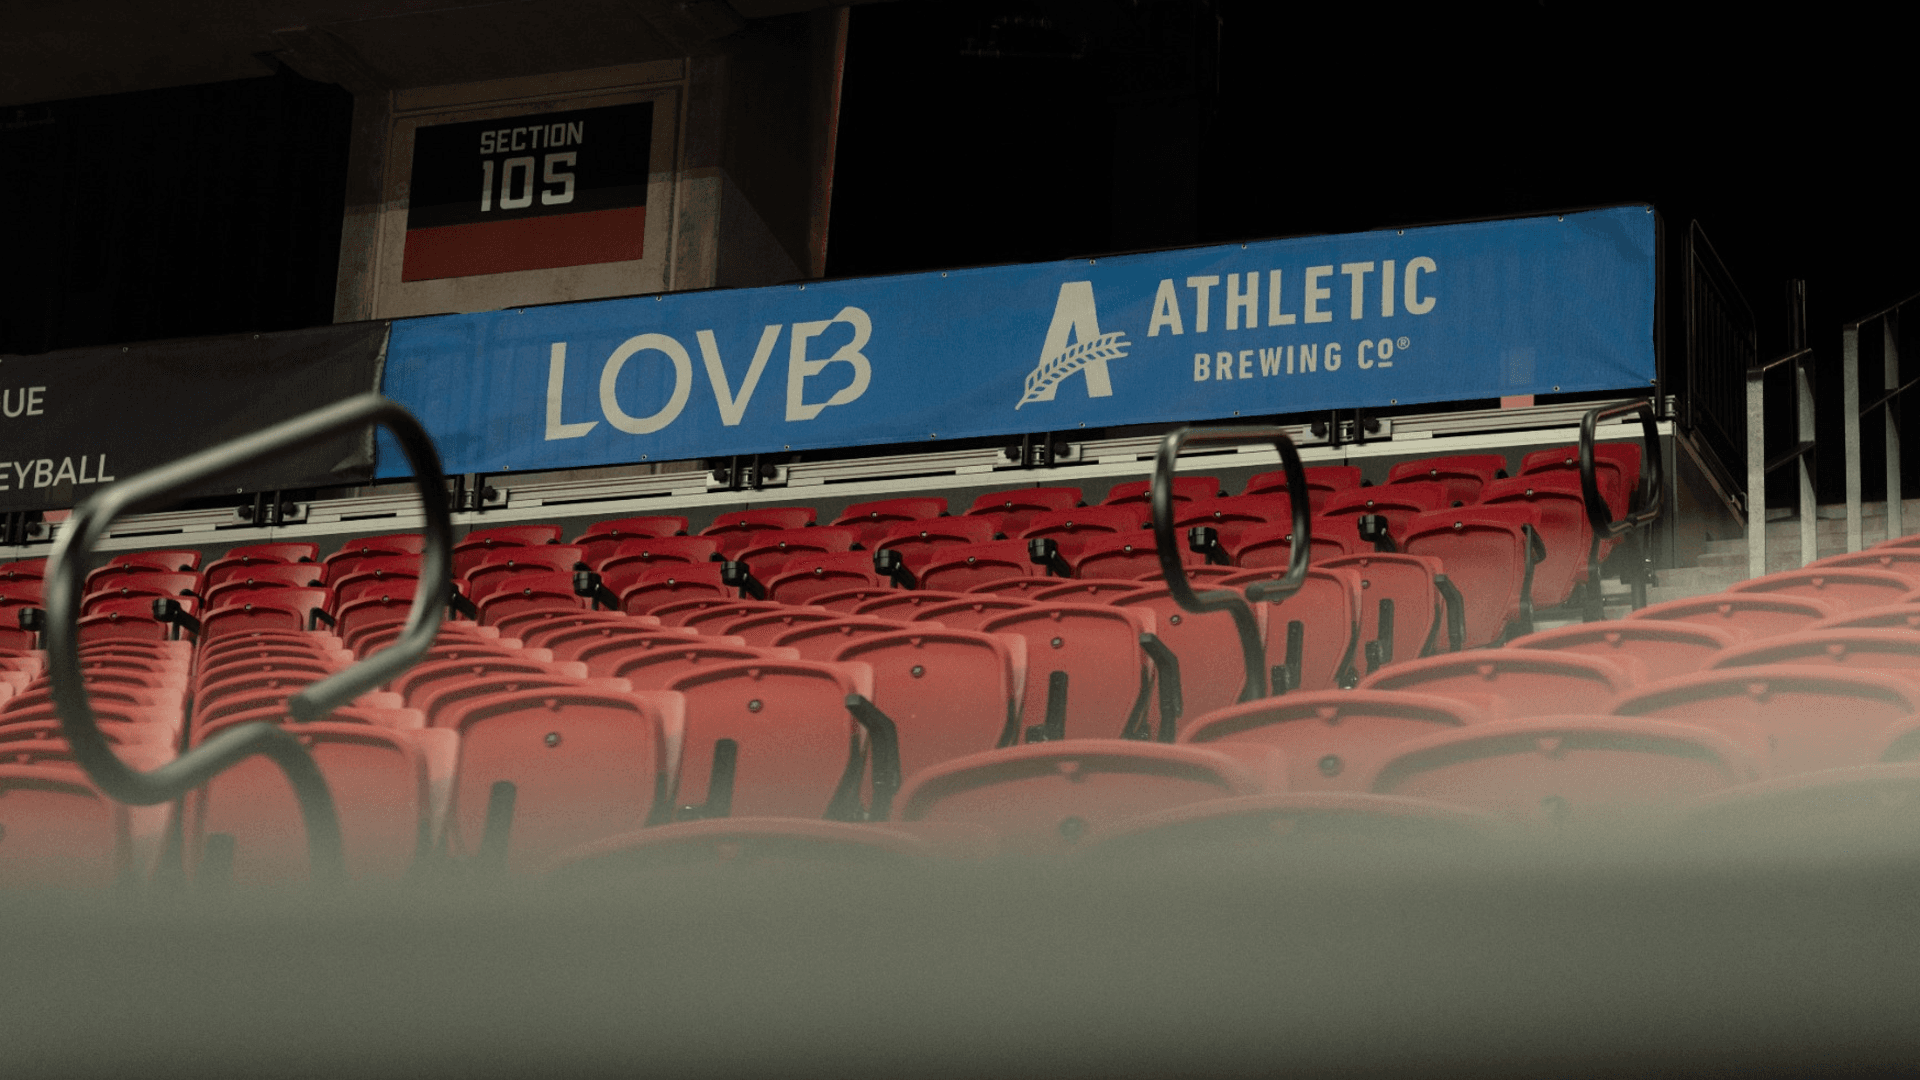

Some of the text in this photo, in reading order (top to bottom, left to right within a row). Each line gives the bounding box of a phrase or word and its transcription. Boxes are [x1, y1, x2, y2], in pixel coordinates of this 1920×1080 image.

[480, 121, 584, 155] SECTION
[480, 151, 577, 212] 105
[1147, 256, 1437, 338] ATHLETIC
[1193, 342, 1342, 382] BREWING
